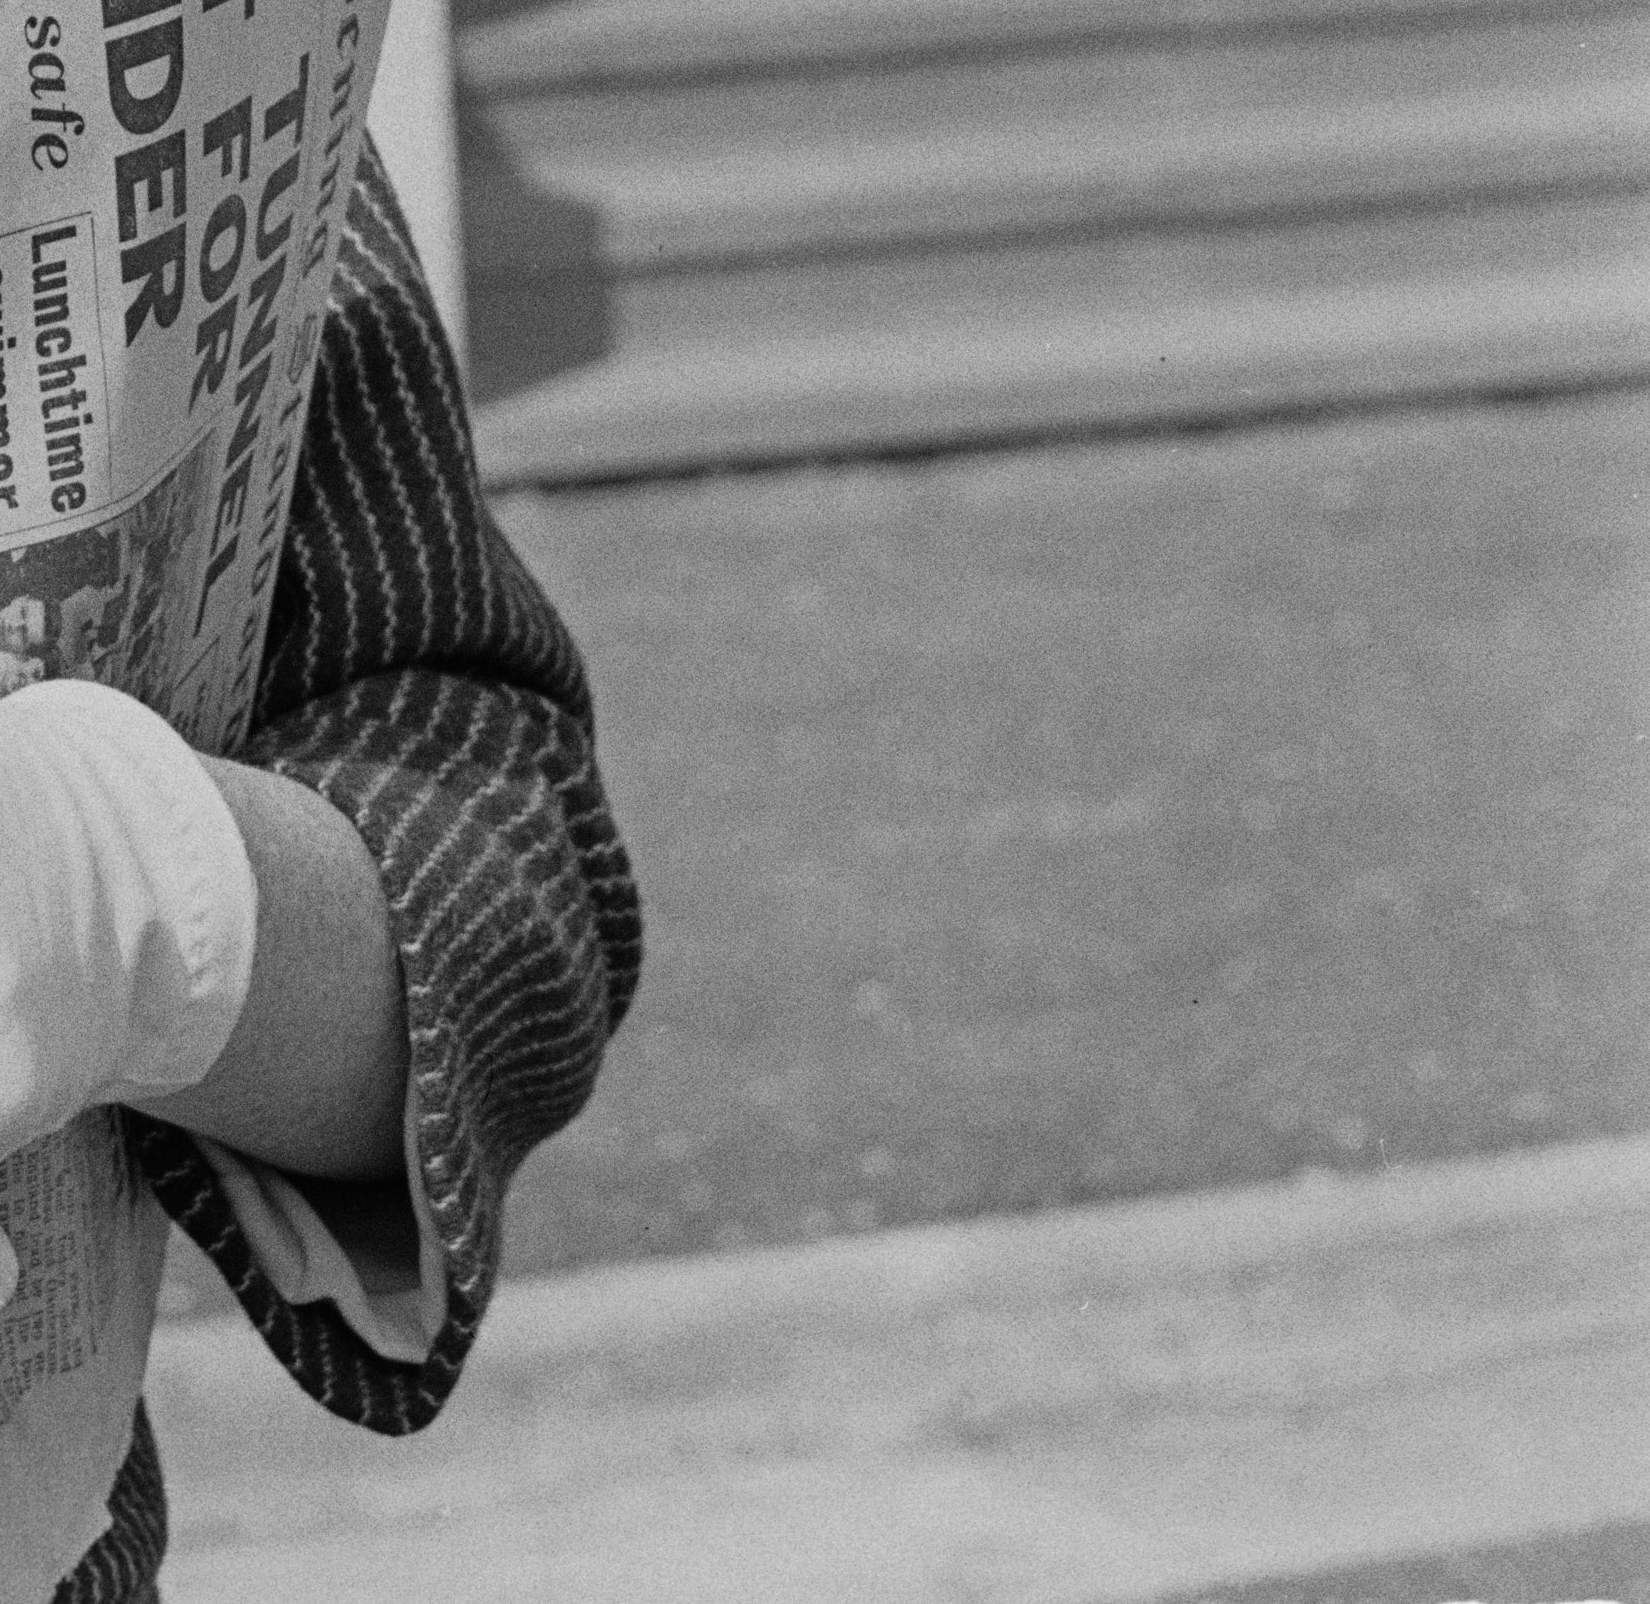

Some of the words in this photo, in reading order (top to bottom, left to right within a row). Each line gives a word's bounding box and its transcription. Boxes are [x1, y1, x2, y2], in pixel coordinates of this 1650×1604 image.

[24, 15, 86, 171] safe
[31, 225, 94, 513] Lunchtime
[189, 95, 252, 415] FOR
[194, 52, 310, 638] TUNNEL
[27, 1151, 43, 1221] England
